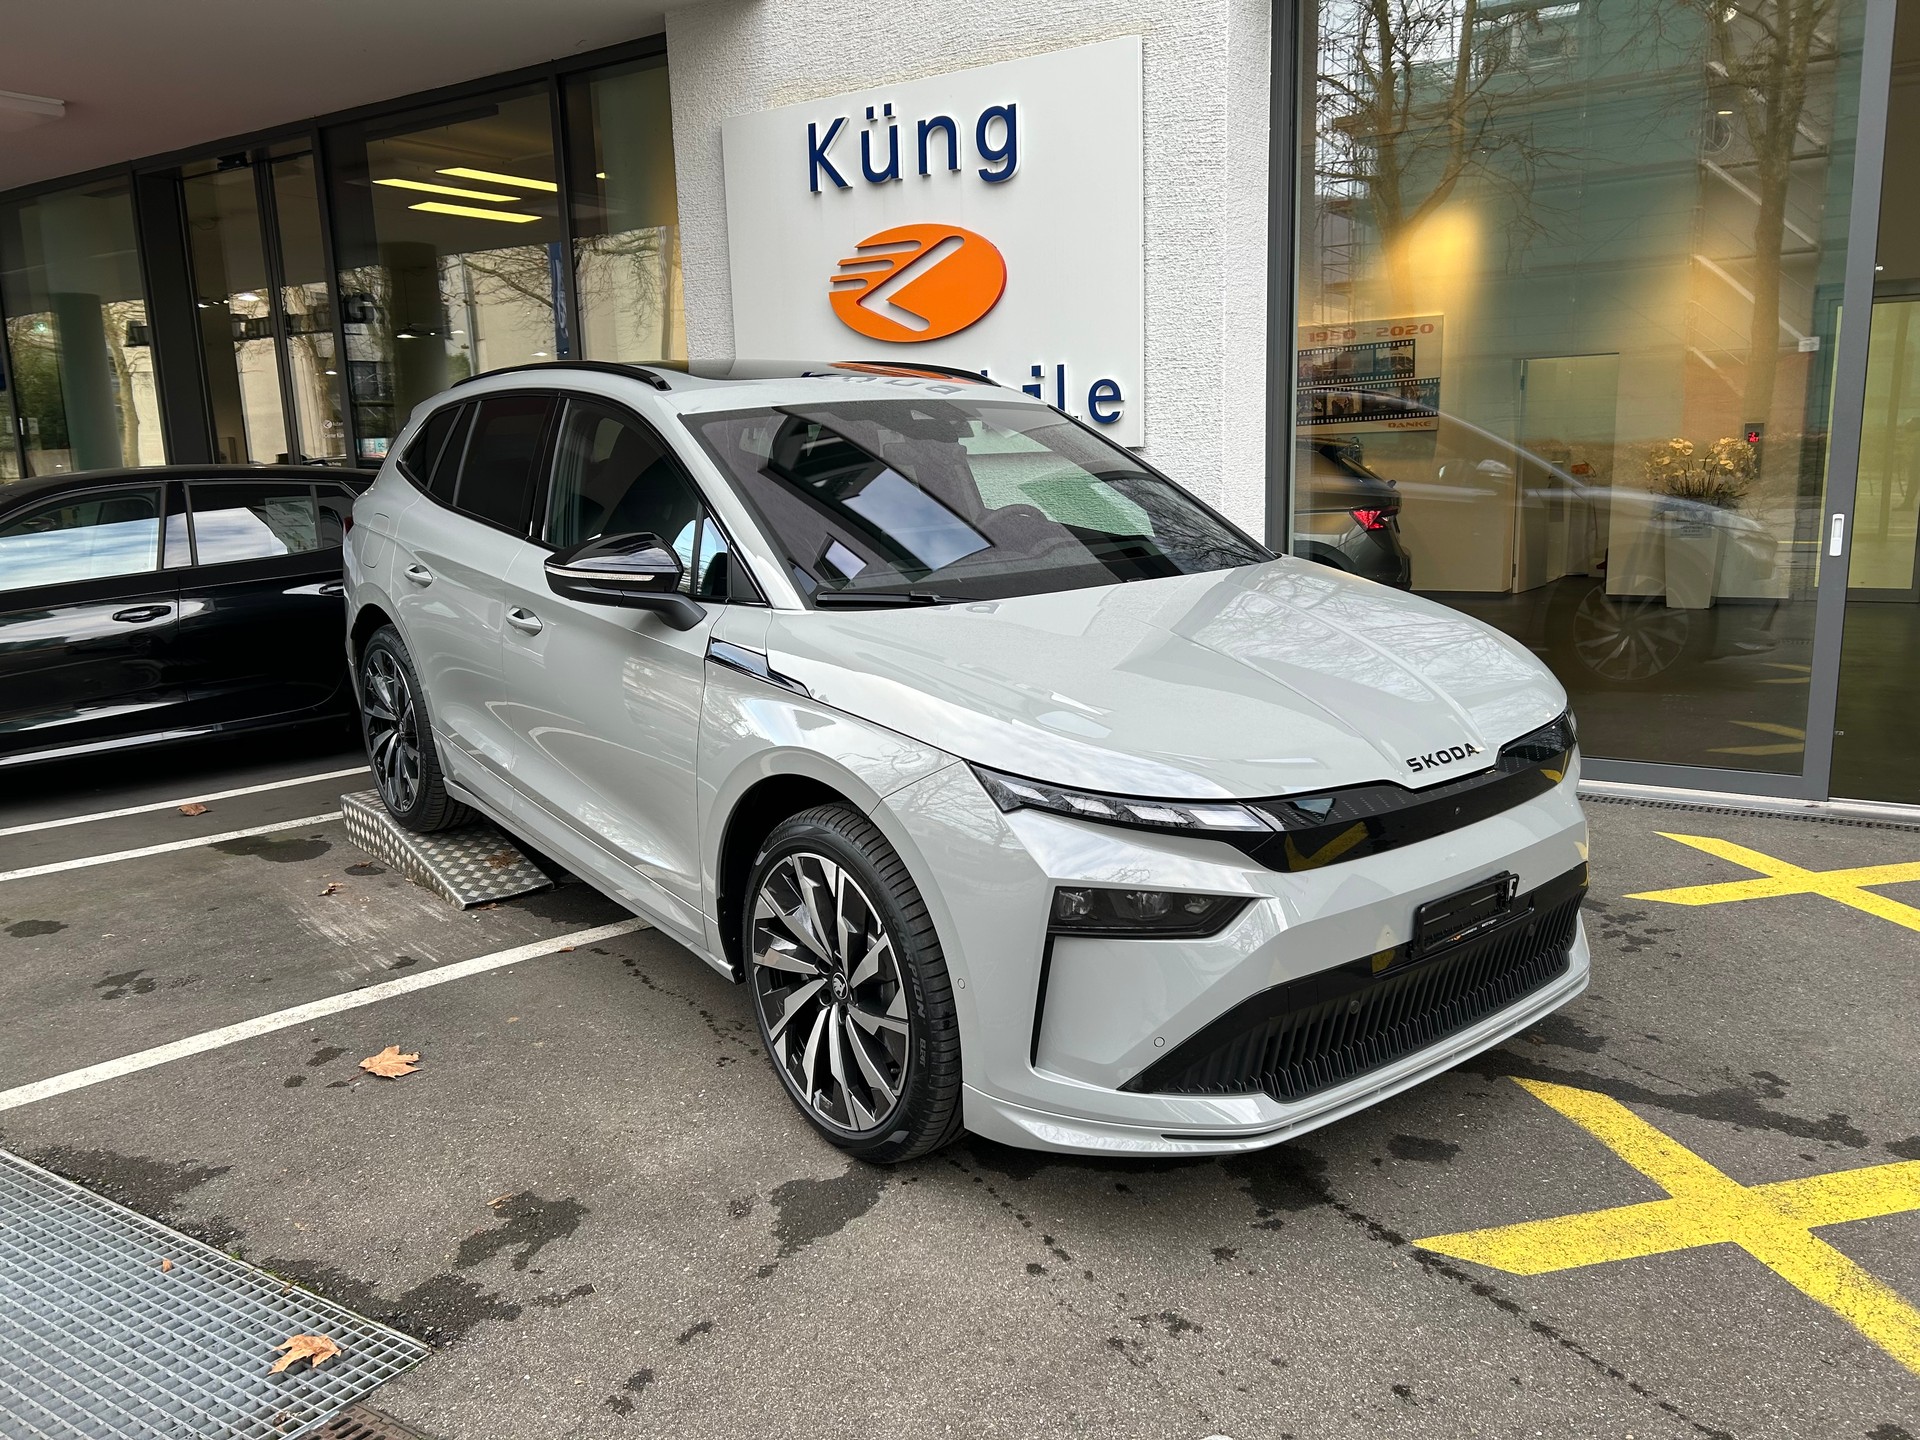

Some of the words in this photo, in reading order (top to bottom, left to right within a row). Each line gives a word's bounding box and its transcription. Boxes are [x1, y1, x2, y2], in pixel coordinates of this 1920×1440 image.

[807, 102, 1019, 192] Küng
[1308, 329, 1357, 343] 1950
[1376, 323, 1434, 338] 2020
[1387, 420, 1432, 429] DANKE
[1405, 742, 1480, 773] SKODA
